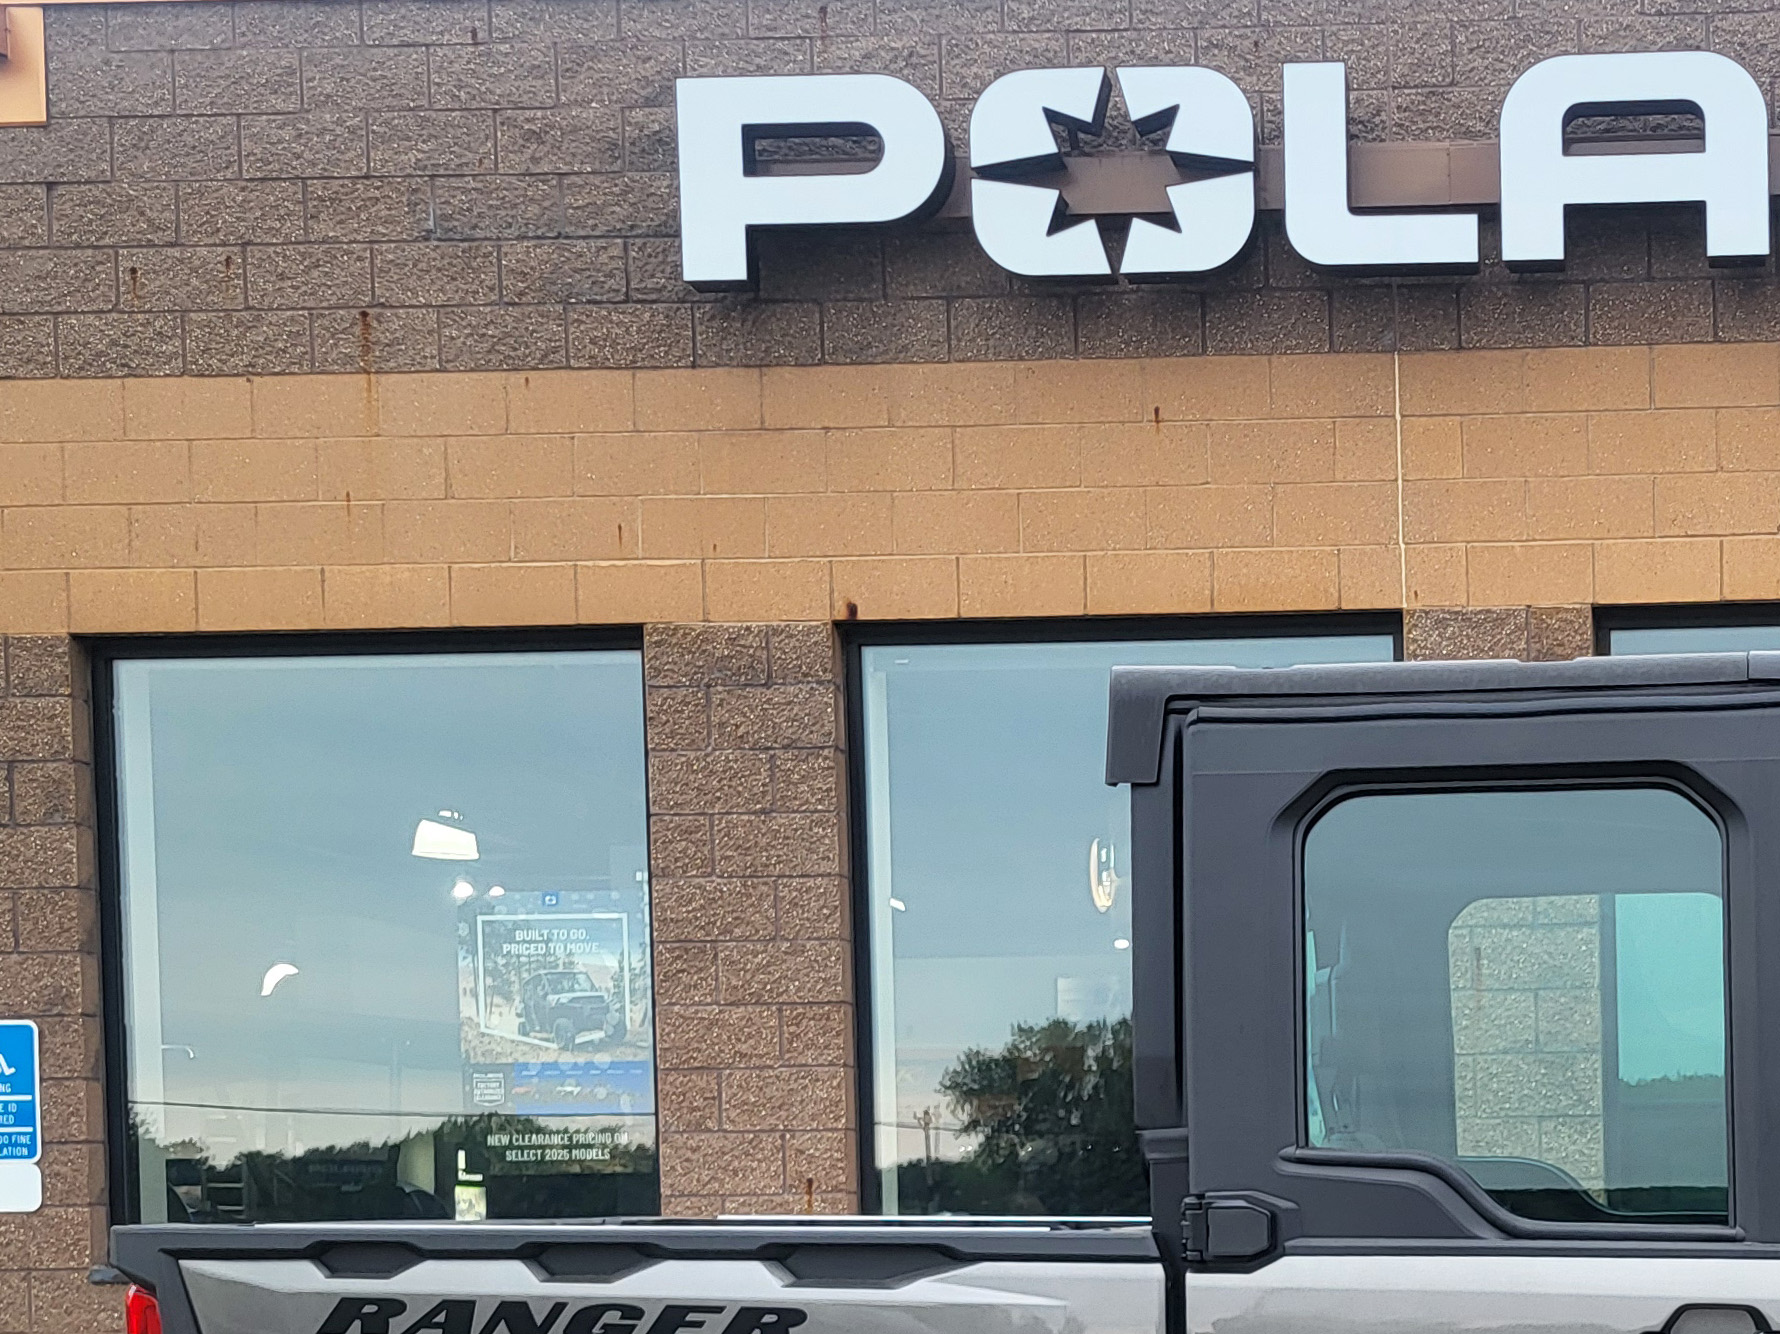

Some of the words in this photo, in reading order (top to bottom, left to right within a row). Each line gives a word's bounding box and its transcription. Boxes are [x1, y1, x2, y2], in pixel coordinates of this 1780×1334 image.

[515, 928, 549, 941] BUILT
[551, 929, 568, 940] TO
[502, 943, 546, 955] PRICED
[548, 943, 564, 954] TO
[8, 1102, 17, 1113] ID
[11, 1134, 32, 1145] FINE
[487, 1133, 510, 1146] NEW
[512, 1132, 571, 1146] CLEARANCE
[572, 1131, 612, 1145] PRICING
[505, 1149, 541, 1162] SELECT
[571, 1147, 611, 1160] MODELS
